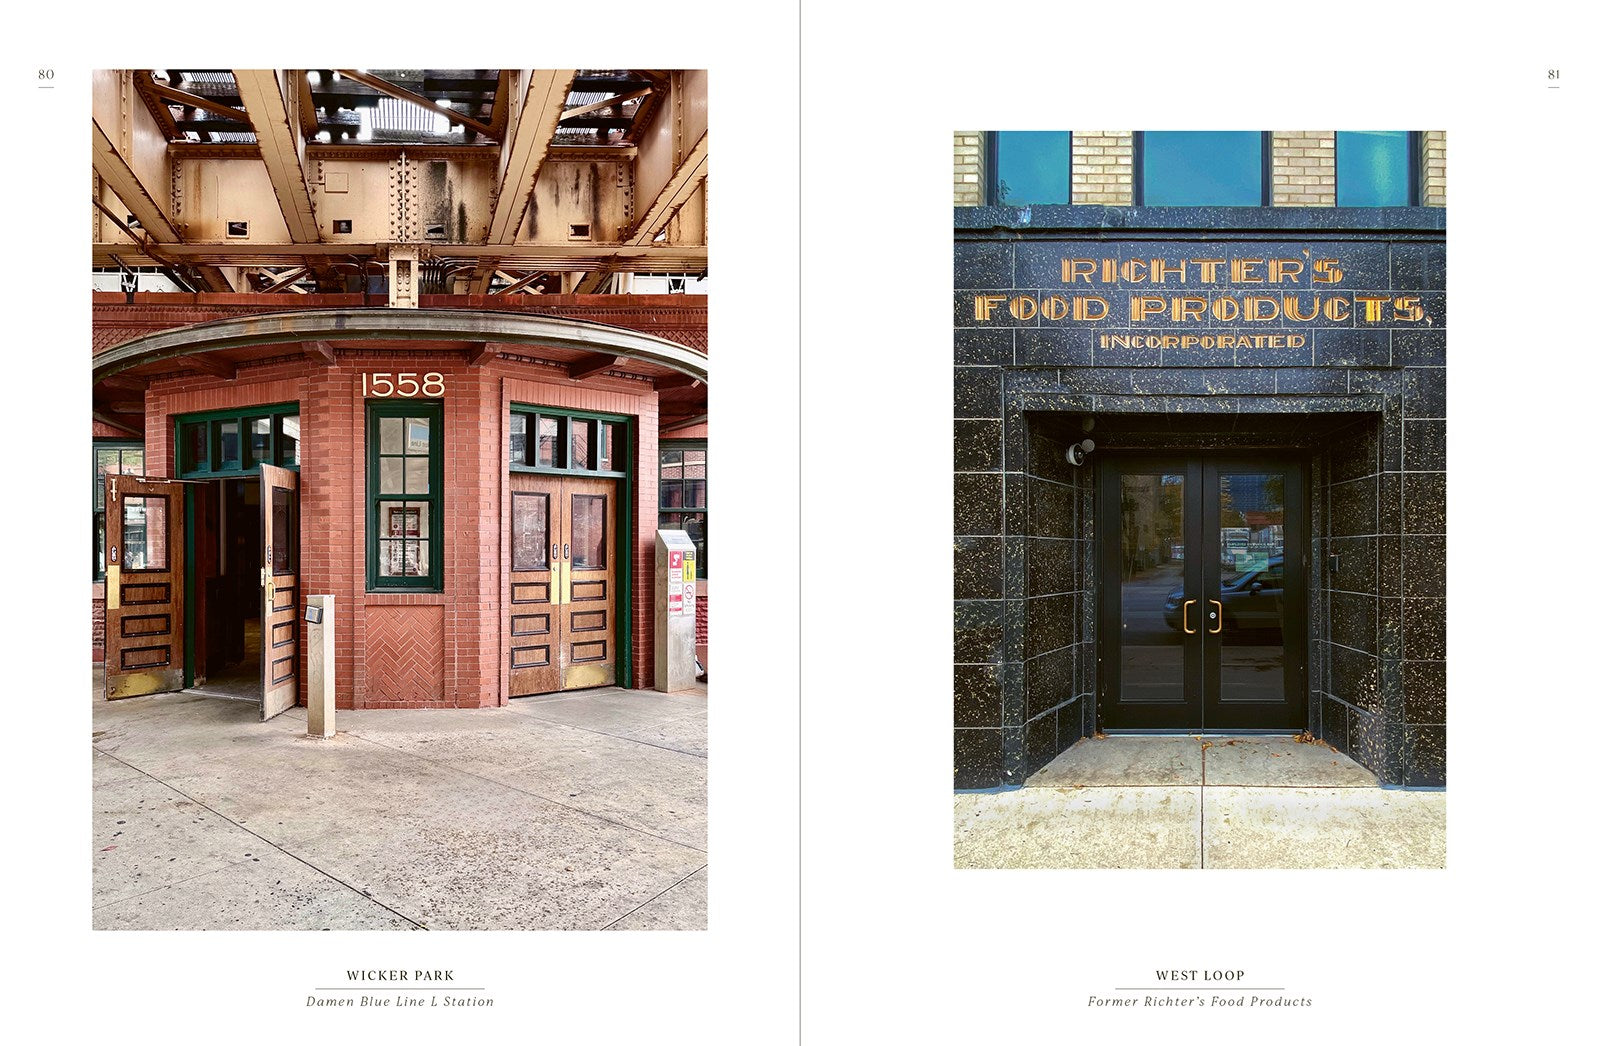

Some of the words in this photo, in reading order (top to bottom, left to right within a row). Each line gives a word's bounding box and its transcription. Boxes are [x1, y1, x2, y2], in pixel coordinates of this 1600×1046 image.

[1061, 248, 1343, 284] RICHTER'S
[974, 295, 1109, 322] FOOD
[1130, 295, 1433, 326] PRODUCTS,
[1100, 334, 1306, 349] INCORPORATED
[362, 372, 445, 397] 1558
